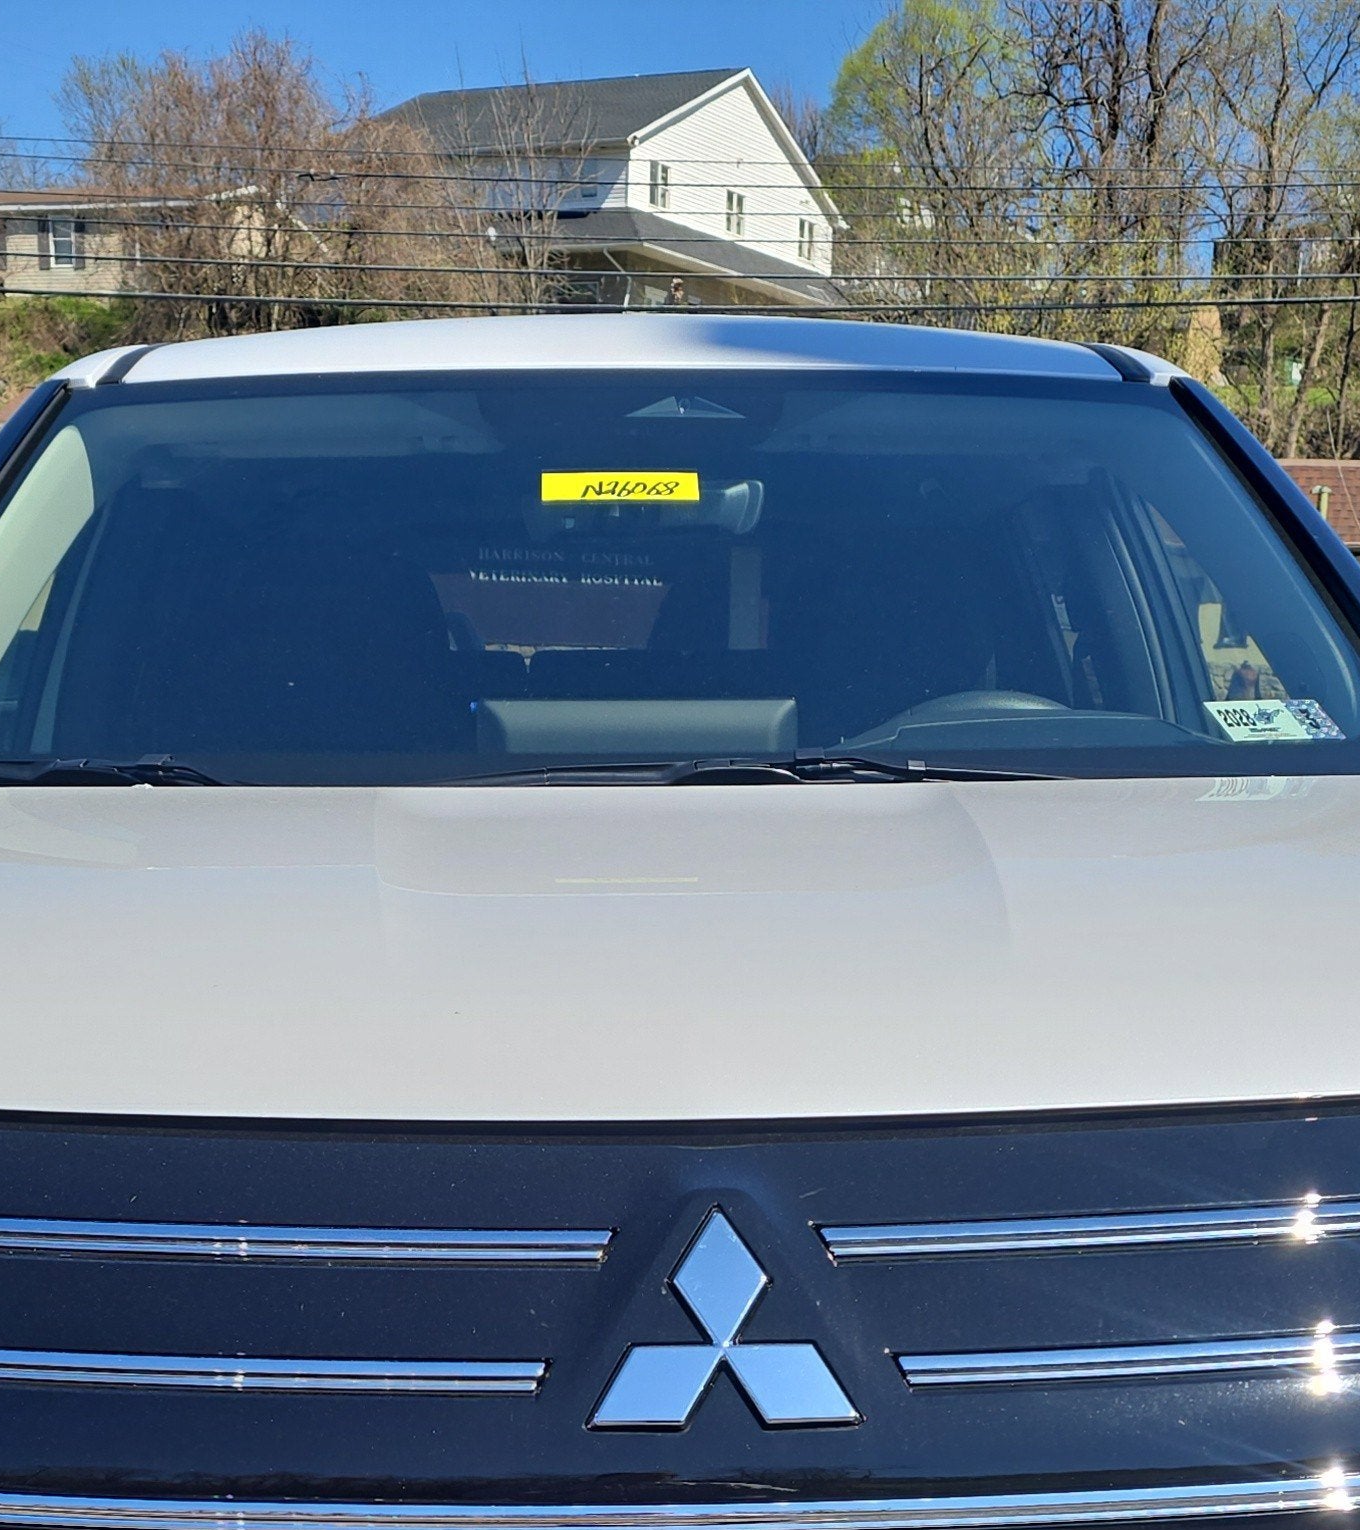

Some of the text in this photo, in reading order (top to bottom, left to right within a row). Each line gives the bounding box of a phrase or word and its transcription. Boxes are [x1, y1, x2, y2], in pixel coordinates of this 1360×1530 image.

[580, 480, 680, 498] N26068
[478, 547, 654, 566] HARRISON CENTRAL
[469, 568, 664, 587] VETERINARY HOSPITAL
[1216, 708, 1258, 728] 2028
